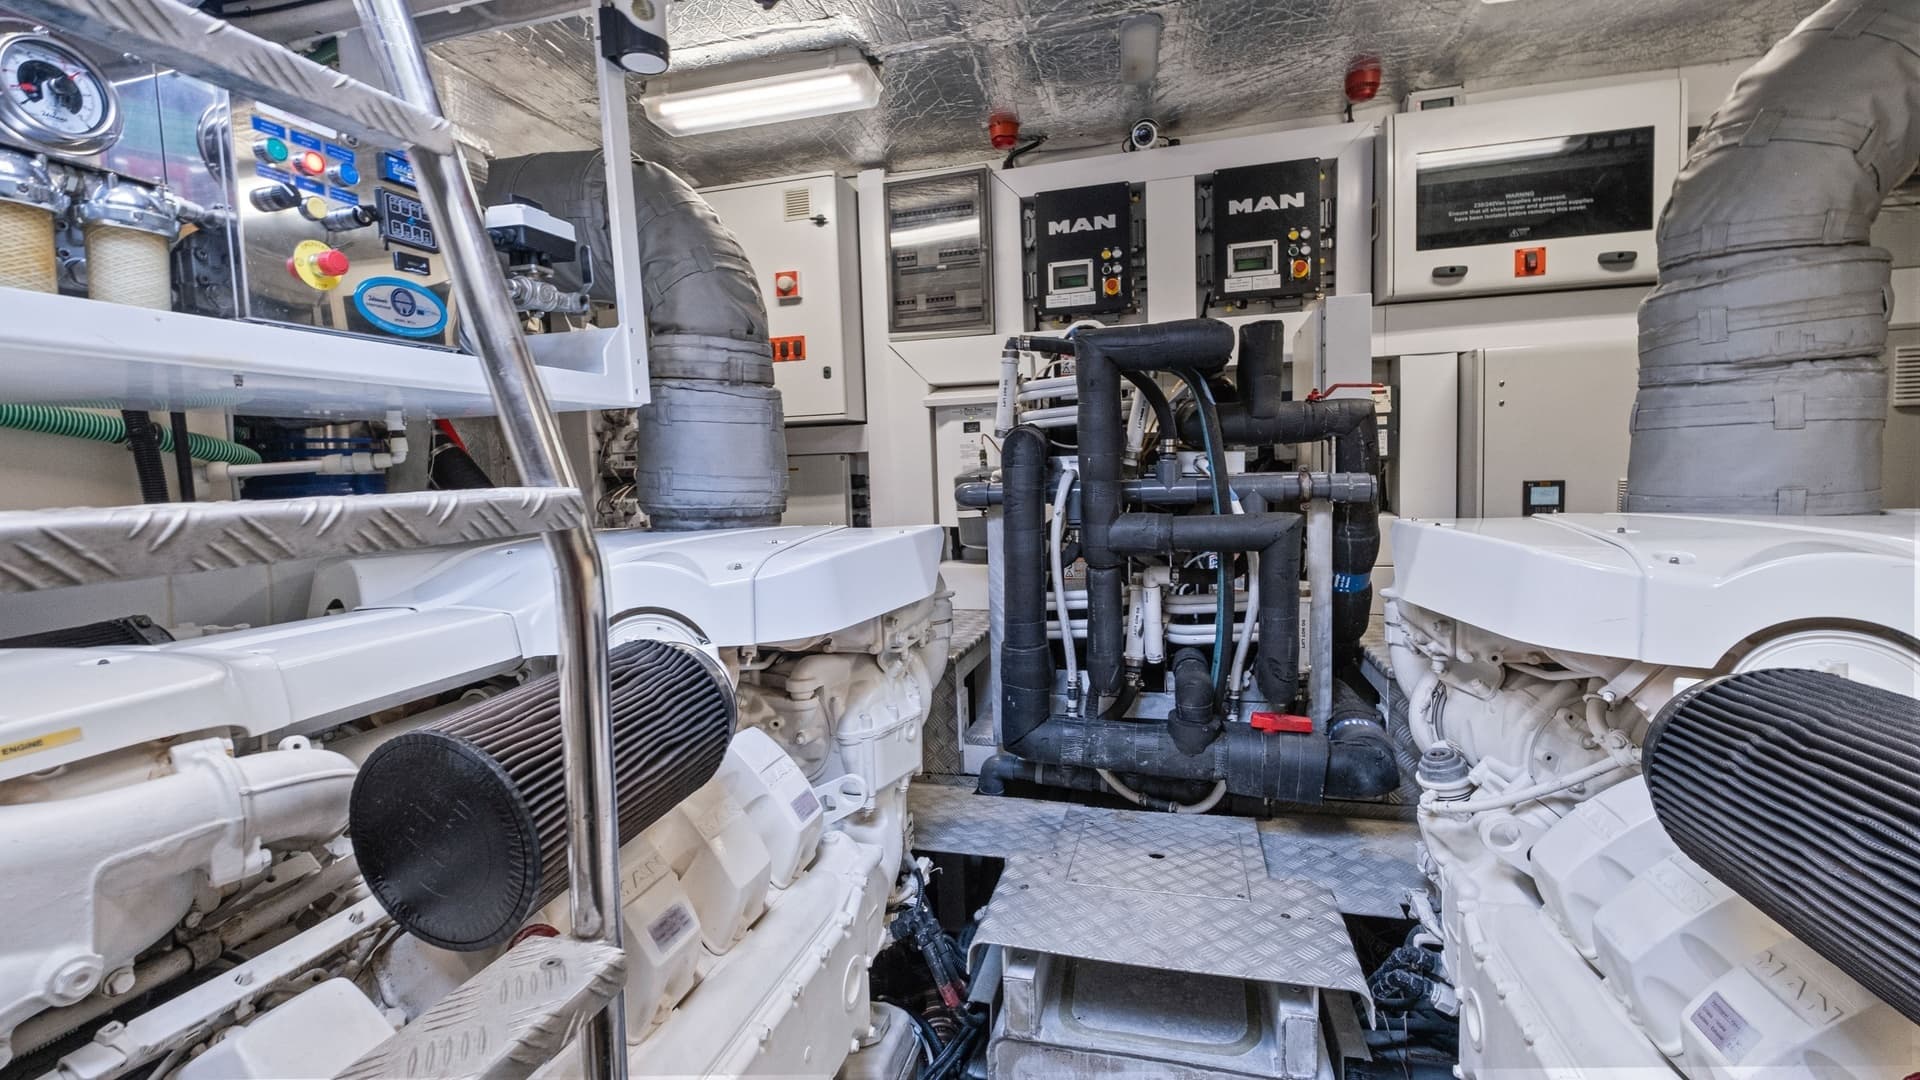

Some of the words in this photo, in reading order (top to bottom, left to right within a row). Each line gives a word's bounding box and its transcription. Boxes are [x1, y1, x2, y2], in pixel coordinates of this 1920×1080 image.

[1228, 192, 1305, 215] MAN
[1505, 191, 1534, 199] WARNING
[1506, 198, 1531, 206] supplies
[1448, 209, 1468, 217] Ensure
[1539, 200, 1567, 209] generator
[1568, 198, 1594, 206] supplies
[1528, 207, 1555, 215] removing
[1557, 205, 1567, 213] this
[1048, 213, 1117, 235] MAN
[2, 738, 43, 756] ENGINE
[1755, 949, 1845, 1026] MAN
